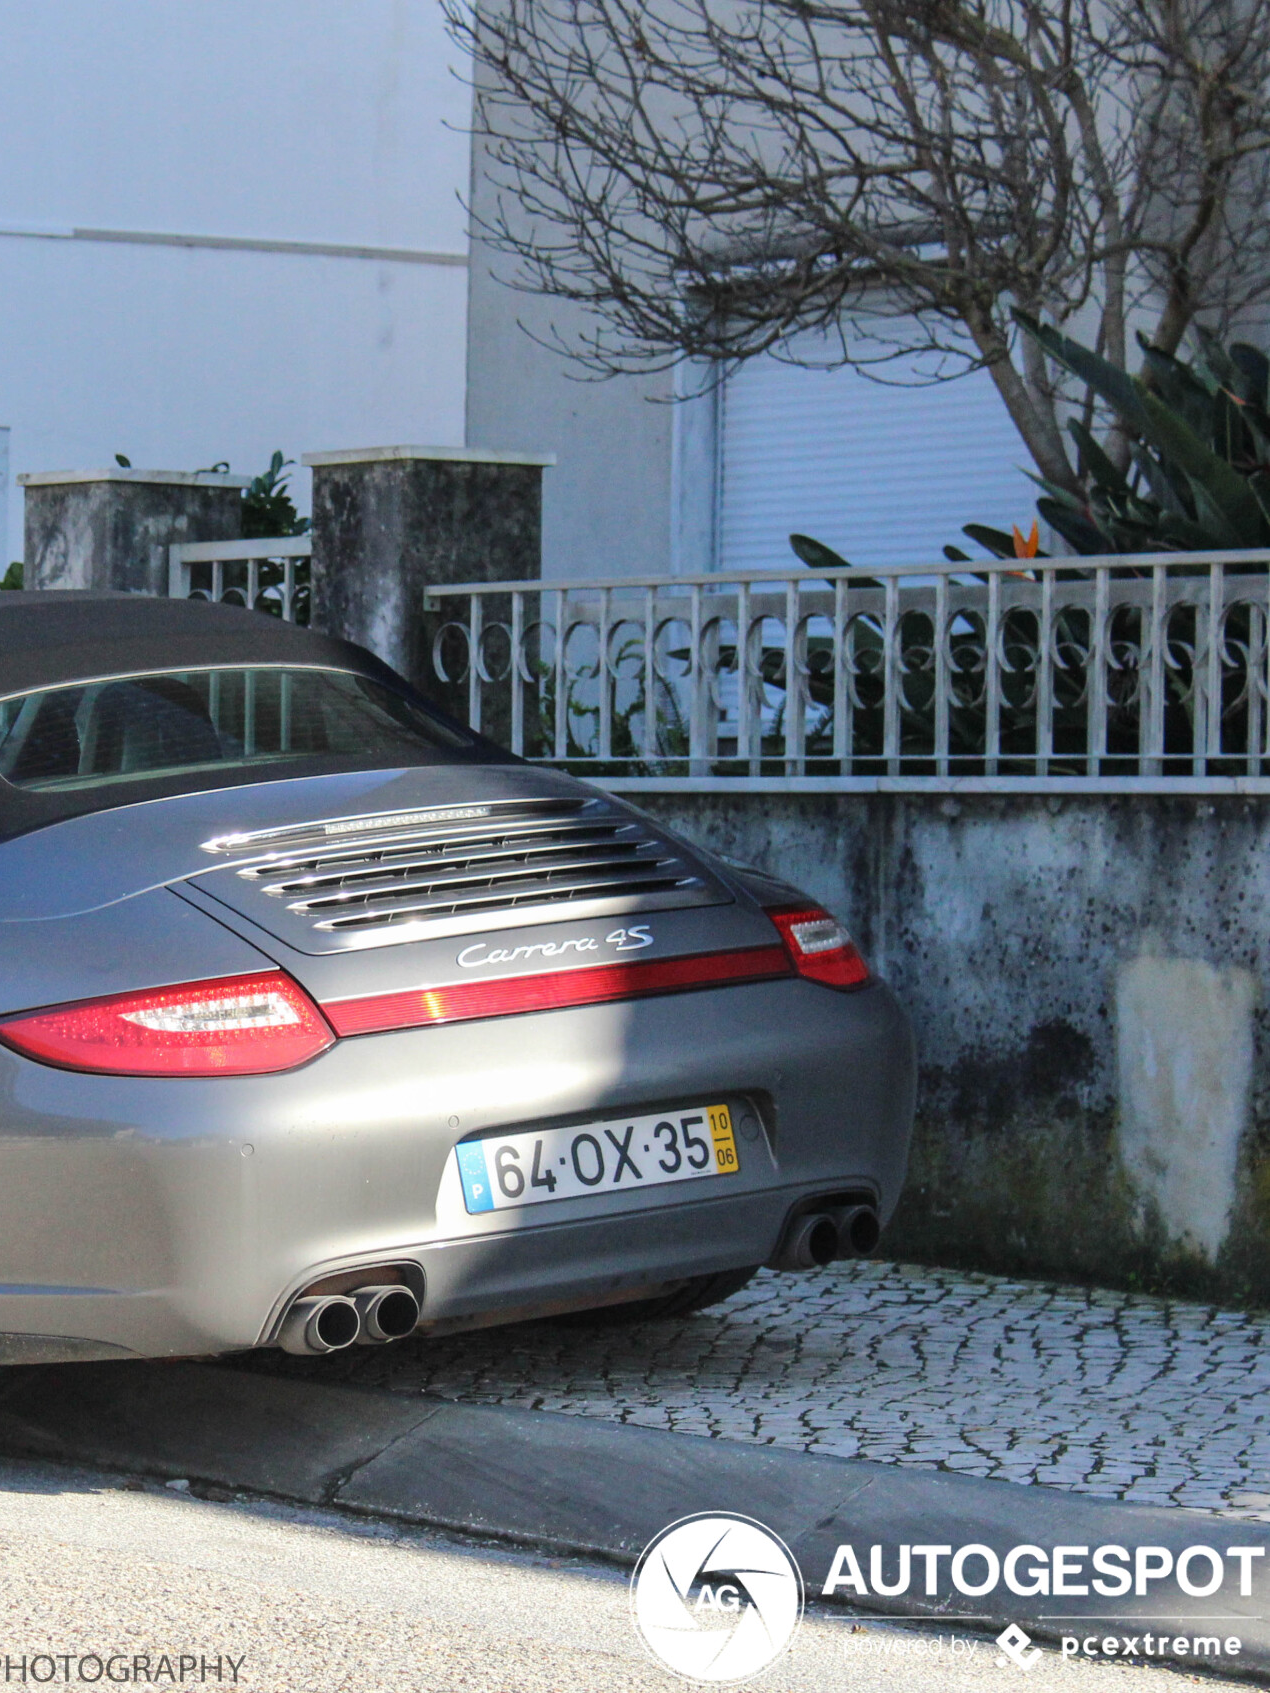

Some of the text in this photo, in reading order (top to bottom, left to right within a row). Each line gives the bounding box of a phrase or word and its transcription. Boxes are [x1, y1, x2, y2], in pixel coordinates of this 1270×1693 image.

[456, 924, 654, 968] Carrera 4S
[709, 1112, 728, 1131] 10
[716, 1148, 735, 1167] 06
[471, 1183, 484, 1199] P
